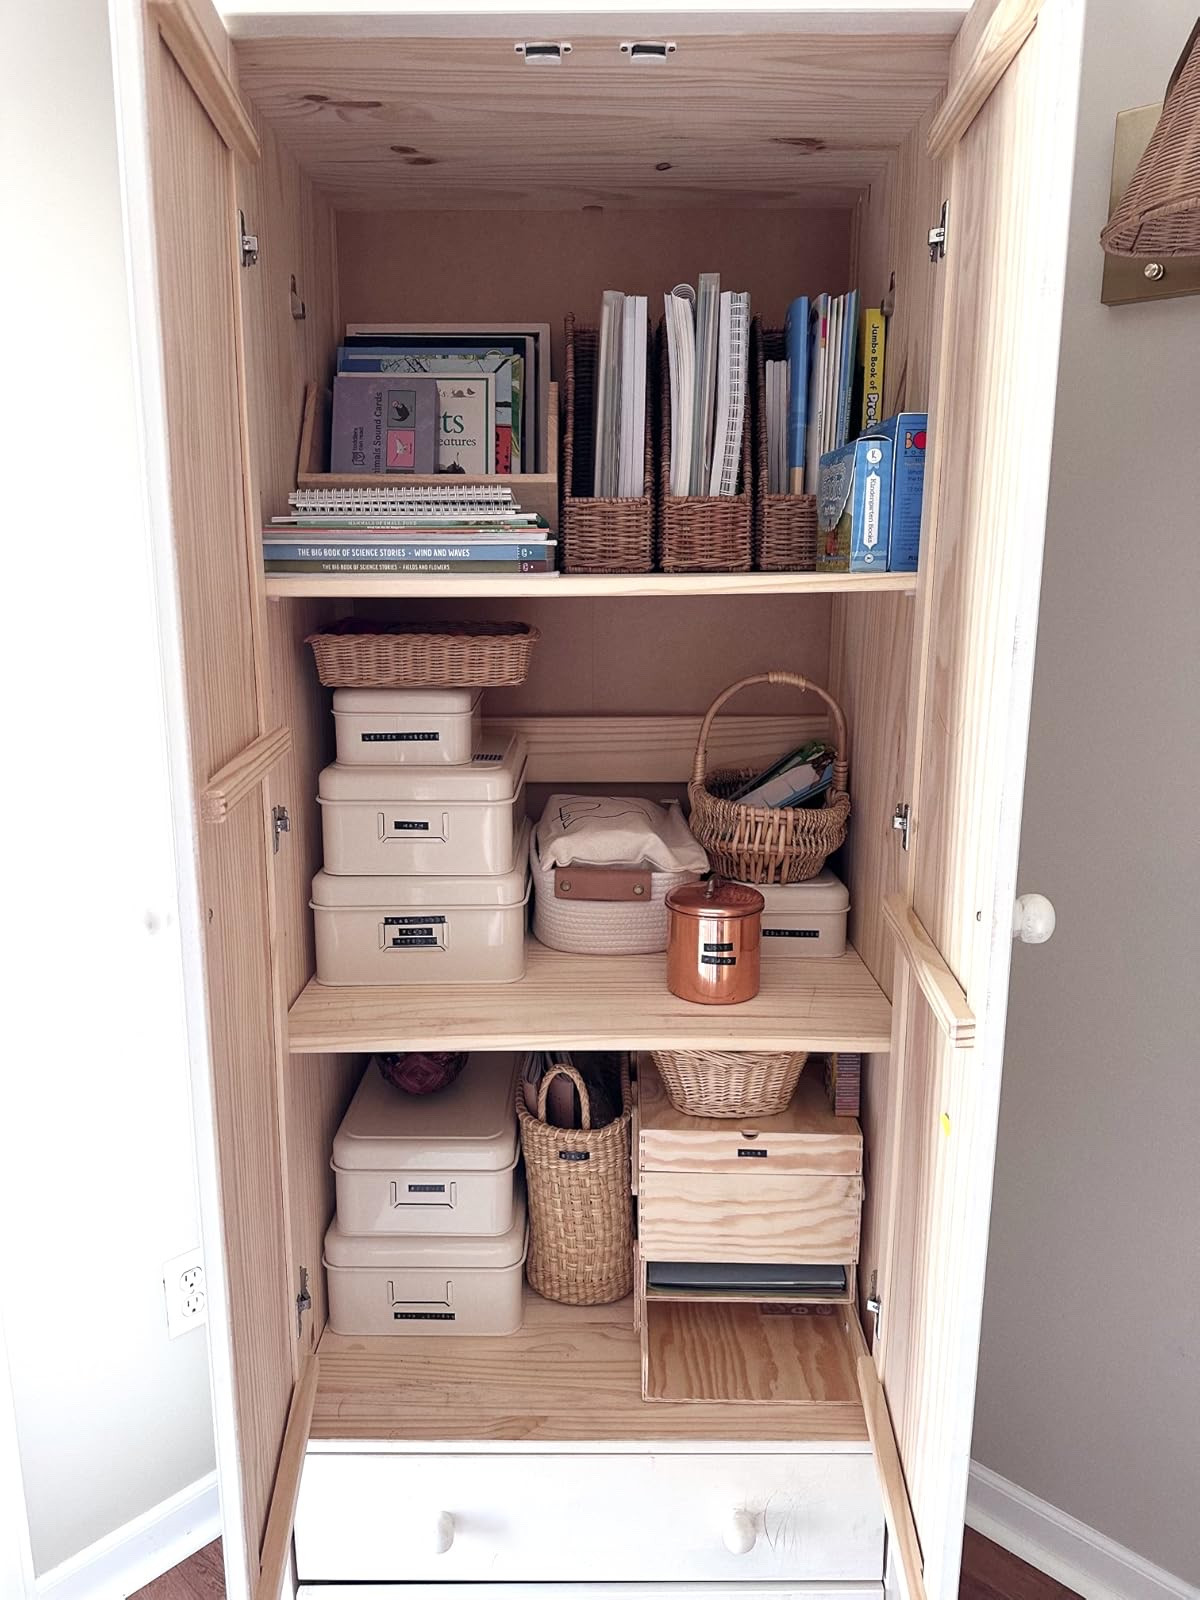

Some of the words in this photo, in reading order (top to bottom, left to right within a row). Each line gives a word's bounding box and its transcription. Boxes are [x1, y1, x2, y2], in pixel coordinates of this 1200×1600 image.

[871, 323, 879, 354] Jumbo
[869, 356, 878, 378] Book
[869, 380, 878, 391] of
[374, 391, 382, 417] Cards
[373, 419, 382, 446] Sound
[438, 411, 465, 434] ts
[868, 478, 878, 523] Kindergarten
[867, 522, 876, 544] Books
[298, 548, 311, 557] THE
[311, 548, 323, 557] BIG
[323, 548, 341, 557] BOOK
[341, 548, 351, 557] OF
[352, 548, 379, 557] SCIENCE
[380, 548, 406, 557] STORIES
[414, 548, 432, 557] WIND
[433, 548, 447, 557] AND
[448, 548, 470, 557] WAVES
[322, 563, 332, 571] THE
[332, 563, 340, 571] BIG
[341, 563, 353, 571] BOOK
[353, 563, 360, 571] OF
[360, 563, 379, 571] SCIENCE
[379, 563, 397, 571] STORIES
[402, 563, 418, 571] FIELDS
[419, 563, 428, 571] AND
[428, 563, 451, 571] FLOWERS
